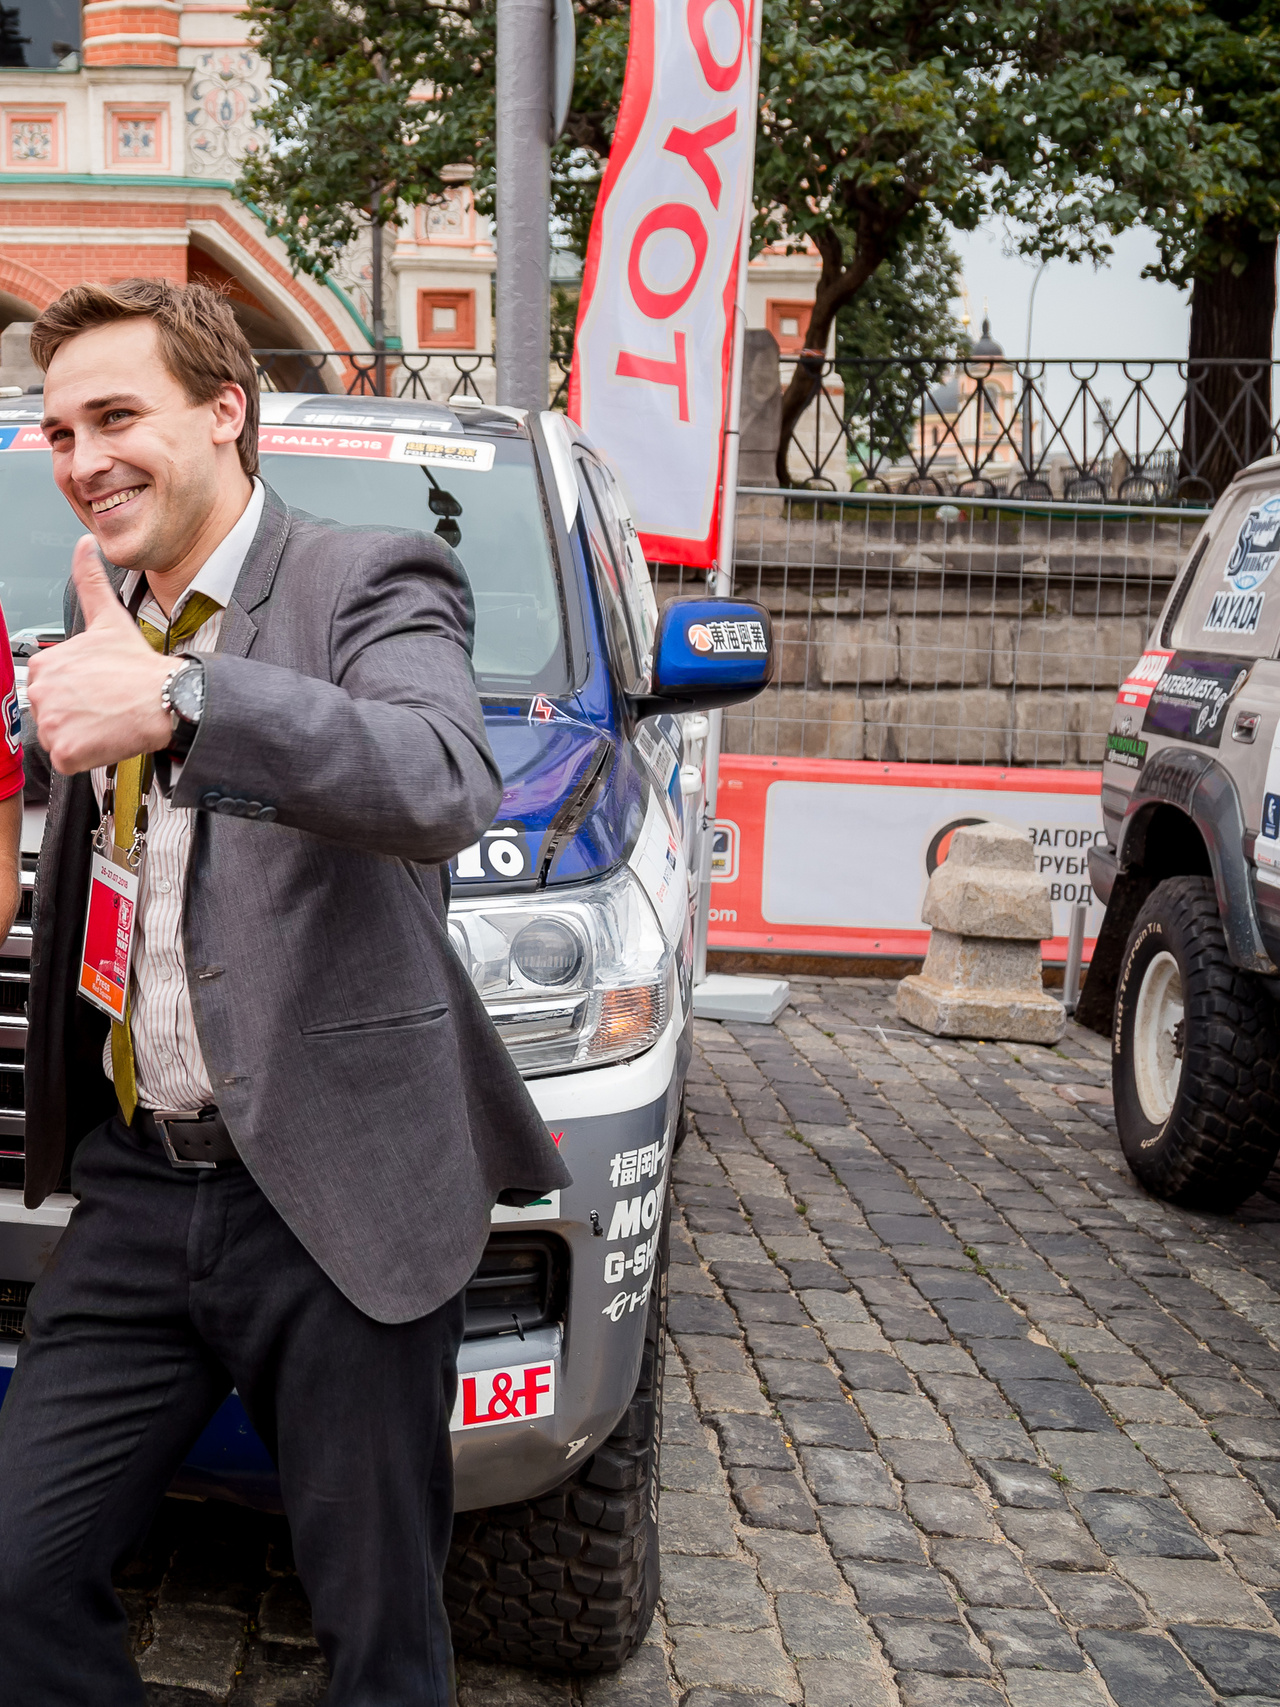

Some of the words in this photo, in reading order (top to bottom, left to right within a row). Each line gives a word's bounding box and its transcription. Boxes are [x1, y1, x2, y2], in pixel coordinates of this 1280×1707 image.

[271, 434, 336, 447] RALLY
[337, 438, 383, 450] 2018
[1204, 594, 1264, 631] NAYADA
[95, 974, 110, 992] Press
[462, 1364, 552, 1427] L&F
